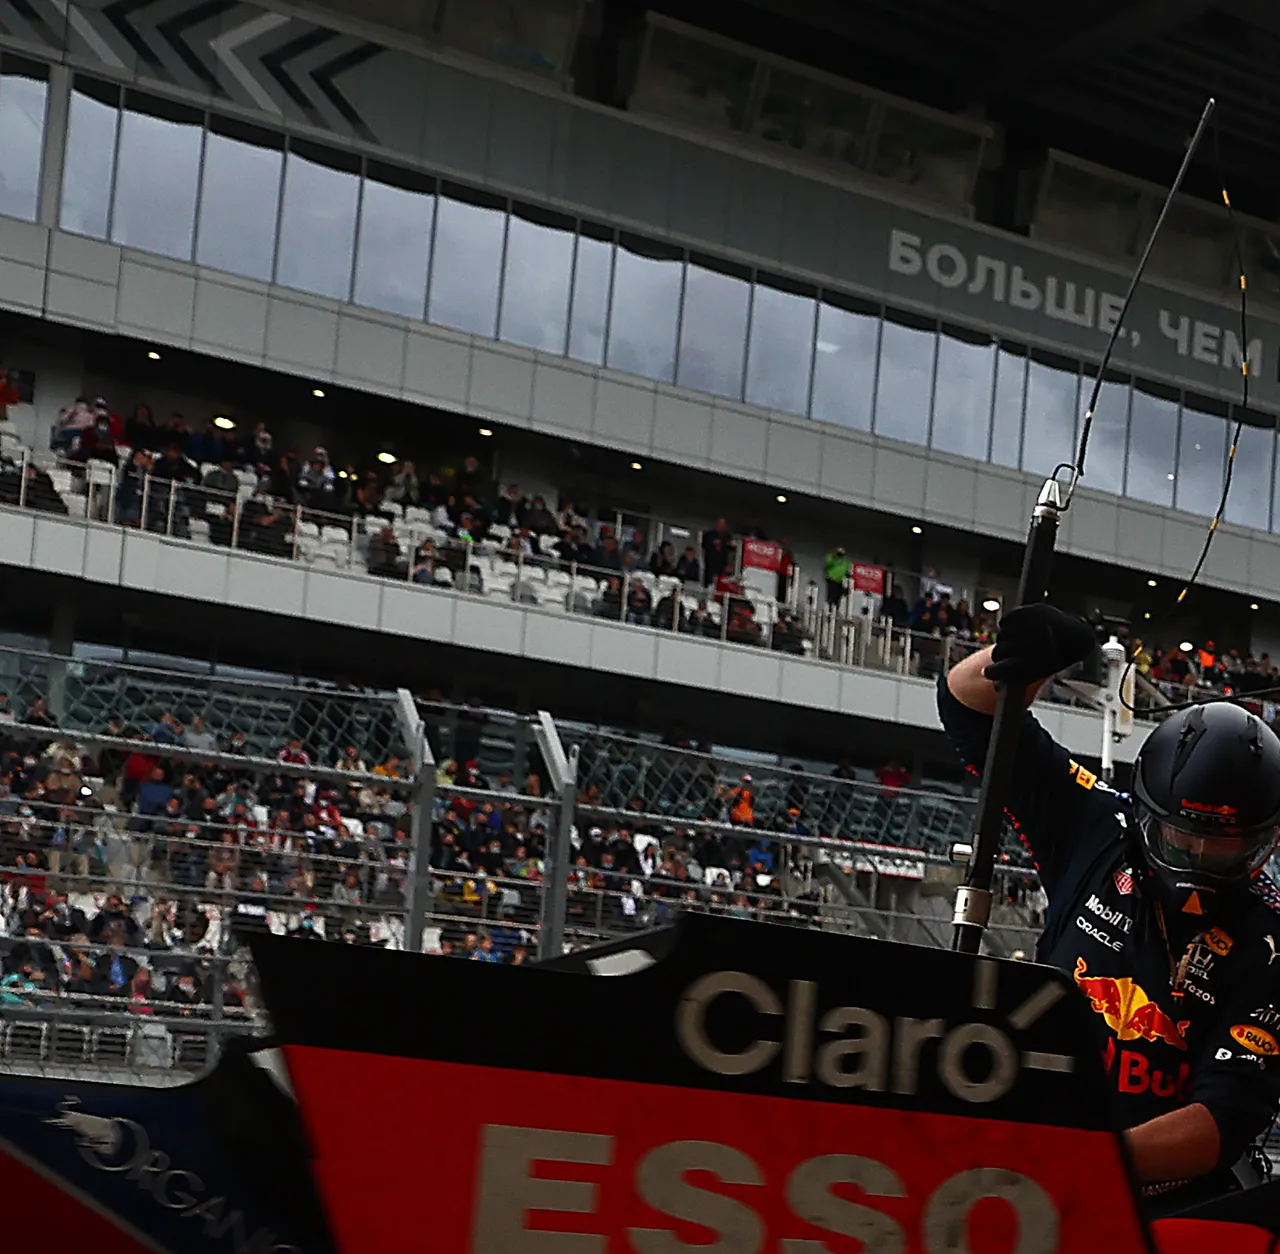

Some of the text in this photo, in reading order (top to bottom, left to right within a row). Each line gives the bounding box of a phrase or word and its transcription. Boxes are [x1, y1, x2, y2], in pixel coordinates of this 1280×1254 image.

[888, 229, 1141, 347] БОЛЬШЕ,
[1159, 310, 1263, 377] ЧЕМ
[1085, 894, 1123, 926] Mobil
[1076, 916, 1124, 952] ORACLE
[1183, 979, 1215, 1005] Tezos
[676, 970, 1018, 1102] Claro
